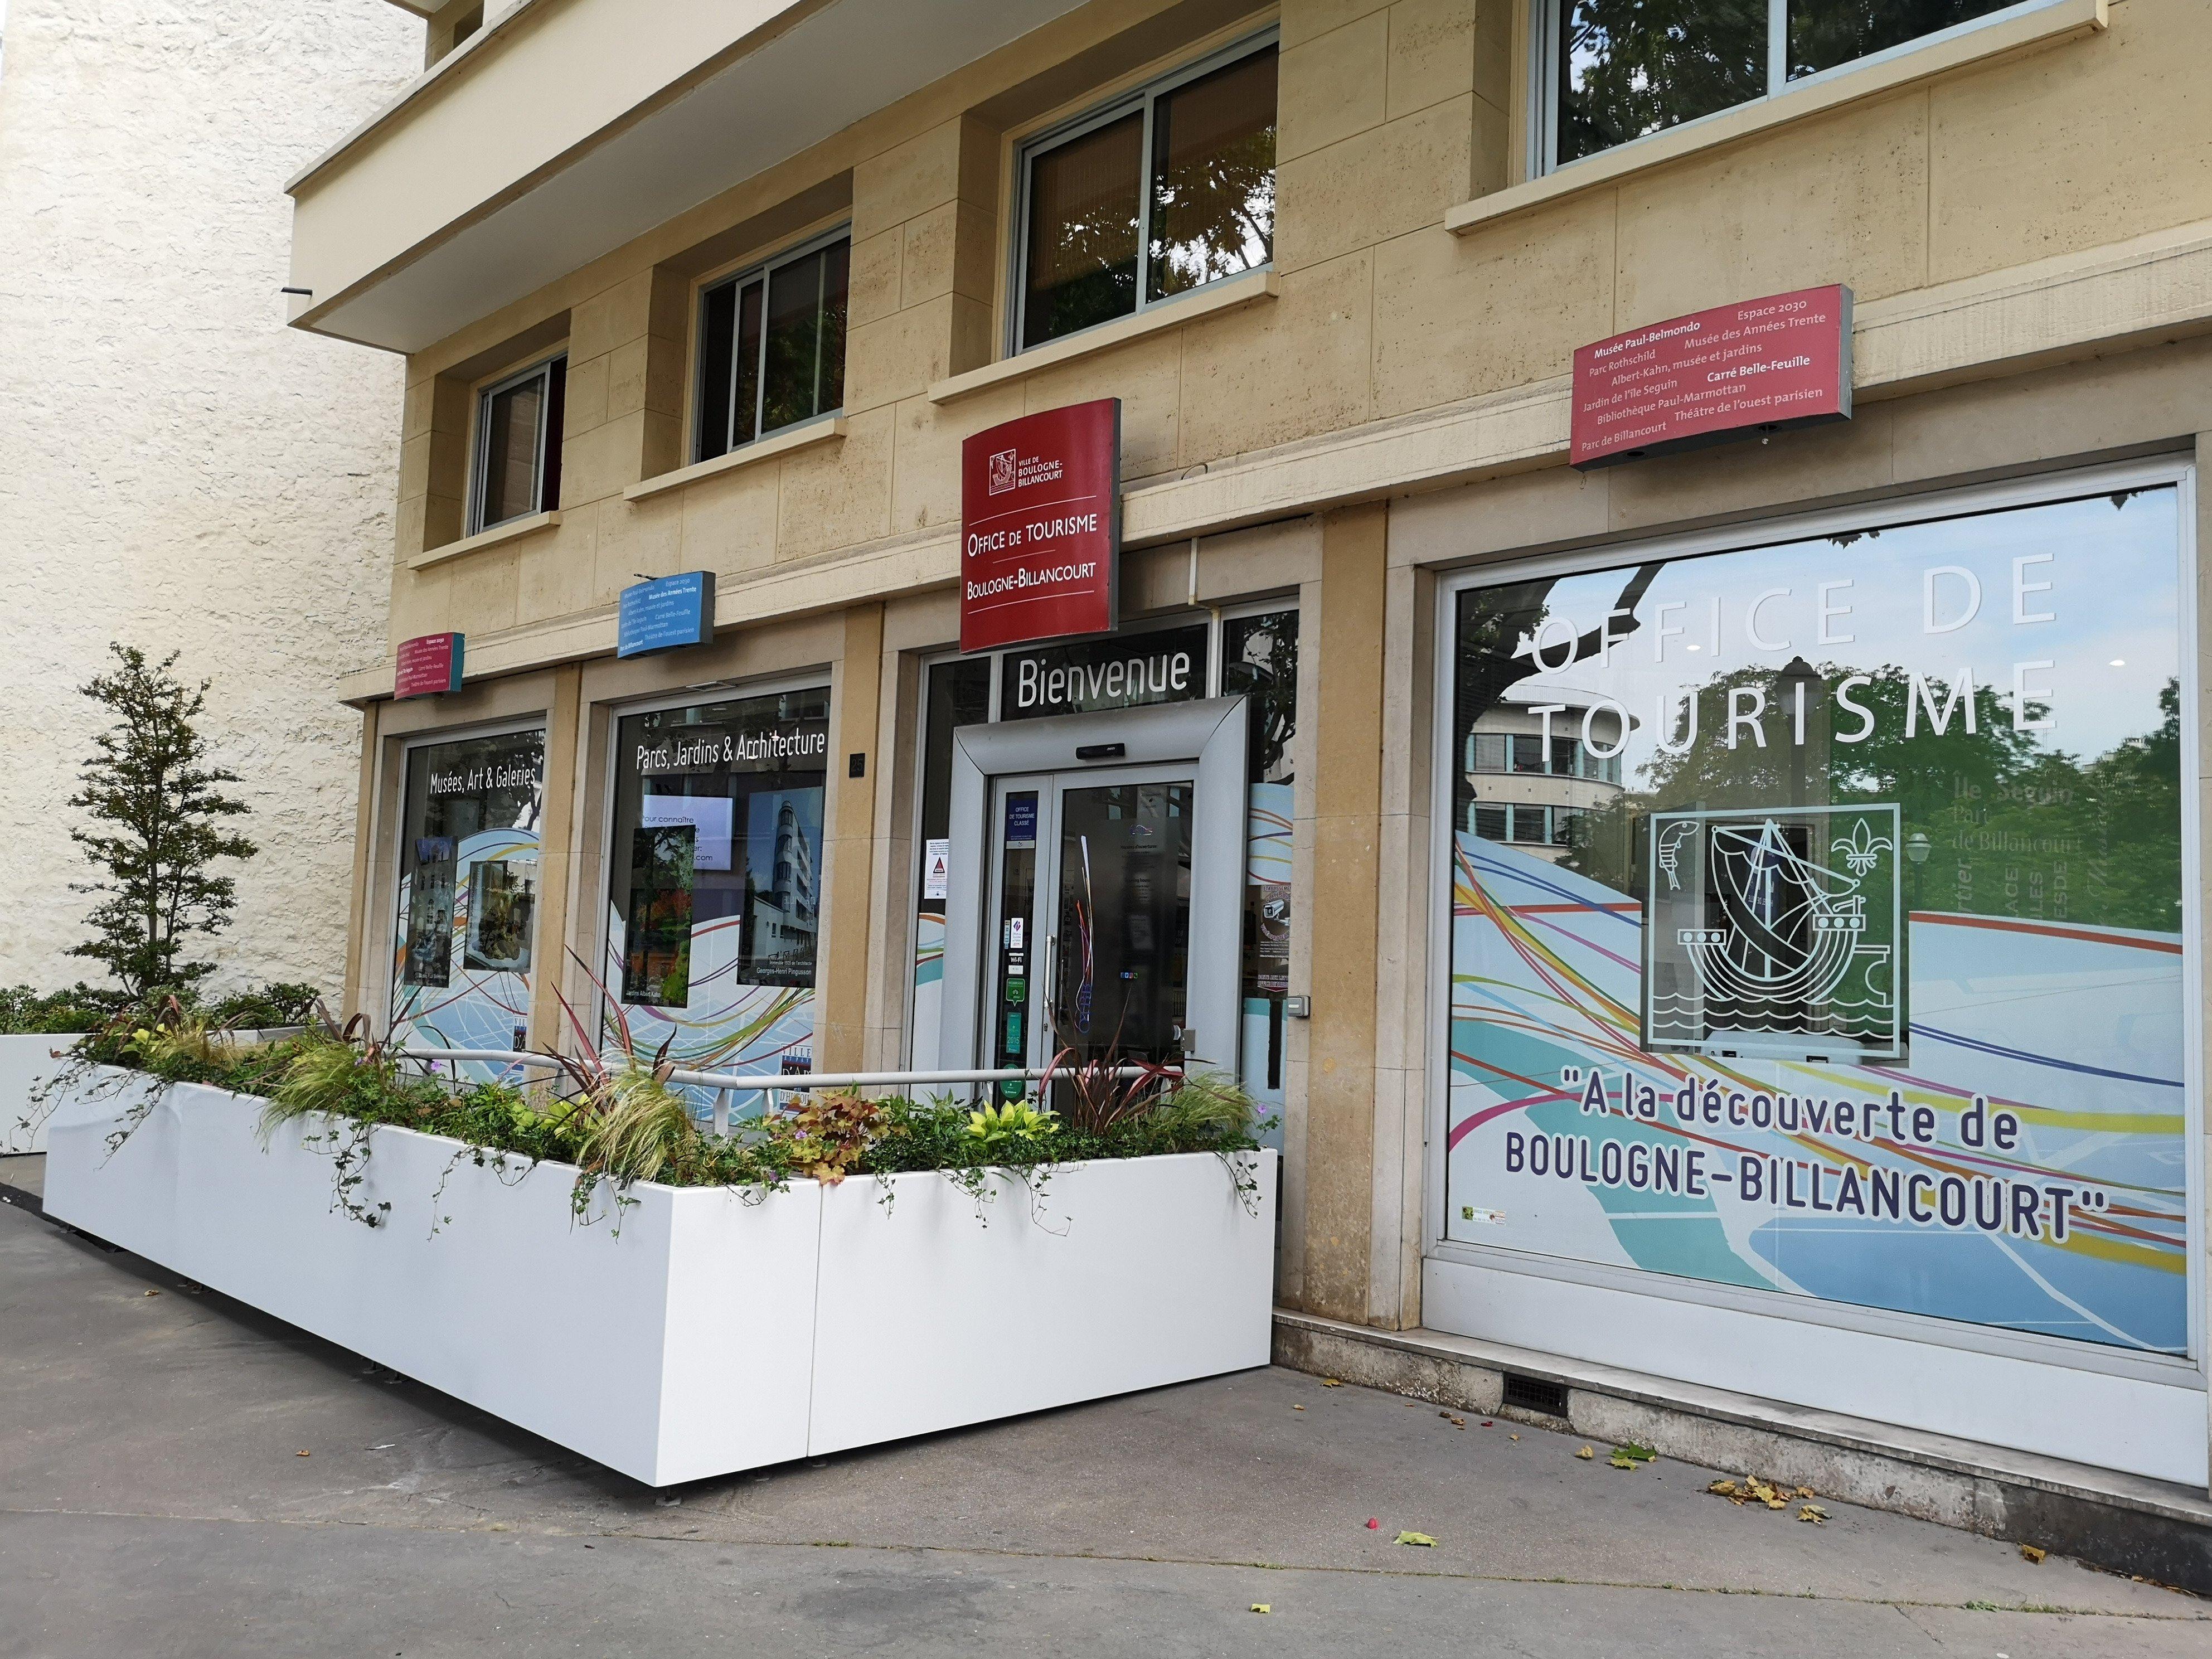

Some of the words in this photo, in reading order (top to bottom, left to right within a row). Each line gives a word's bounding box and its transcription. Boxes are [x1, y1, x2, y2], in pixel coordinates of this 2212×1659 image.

[1738, 304, 1775, 321] Espace
[1778, 299, 1807, 314] 2030
[1594, 341, 1623, 358] Musée
[1626, 321, 1700, 349] Paul-Belmondo
[1685, 332, 1720, 350] Musée
[1722, 329, 1740, 342] des
[1743, 321, 1785, 337] Années
[1788, 313, 1826, 328] Trente
[1589, 363, 1607, 377] Parc
[1609, 349, 1656, 371] Rothschild
[1611, 363, 1671, 387] Albert-Kahn,
[1673, 354, 1707, 370] musée
[1710, 351, 1720, 362] et
[1722, 343, 1762, 361] jardins
[1707, 368, 1737, 384] Carré
[1740, 356, 1811, 377] Belle-Feuille
[1583, 395, 1610, 413] Jardin
[1612, 391, 1622, 403] de
[1624, 387, 1642, 401] l'île
[1643, 379, 1678, 399] Seguin
[1597, 401, 1656, 425] Bibliothèque
[1658, 382, 1747, 410] Paul-Marmottan
[1675, 404, 1715, 423] Théâtre
[1717, 401, 1731, 414] de
[1733, 395, 1772, 411] l'ouest
[1773, 387, 1823, 406] parisien
[1582, 438, 1599, 452] Parc
[1601, 434, 1612, 446] de
[1614, 421, 1667, 443] Billancourt
[1018, 458, 1031, 466] VILLE
[1018, 460, 1063, 477] BOULOGNE-
[1018, 469, 1063, 487] BILLANCOURT
[968, 531, 1005, 557] OFFICE
[1009, 530, 1021, 545] DE
[1026, 513, 1097, 542] TOURISME
[967, 562, 1097, 600] BOULOGNE-BILLANCOURT
[1532, 579, 1856, 676] OFFICE
[1923, 552, 2056, 636] DE
[1018, 652, 1190, 708] Bienvenue
[1527, 659, 2056, 764] TOURISME
[637, 745, 670, 770] Parcs,
[673, 738, 719, 767] Jardins
[723, 736, 733, 761] &
[736, 727, 825, 760] Architecture
[430, 770, 464, 794] Musées,
[467, 767, 483, 790] Art
[486, 767, 493, 789] &
[496, 764, 536, 788] Galeries
[788, 968, 812, 976] Pingusson
[1564, 1069, 1608, 1115] "A
[1623, 1073, 1656, 1118] la
[1677, 1077, 1935, 1143] découverte
[1961, 1093, 2019, 1151] de
[1506, 1131, 2106, 1240] BOULOGNE-BILLANCOURT"
